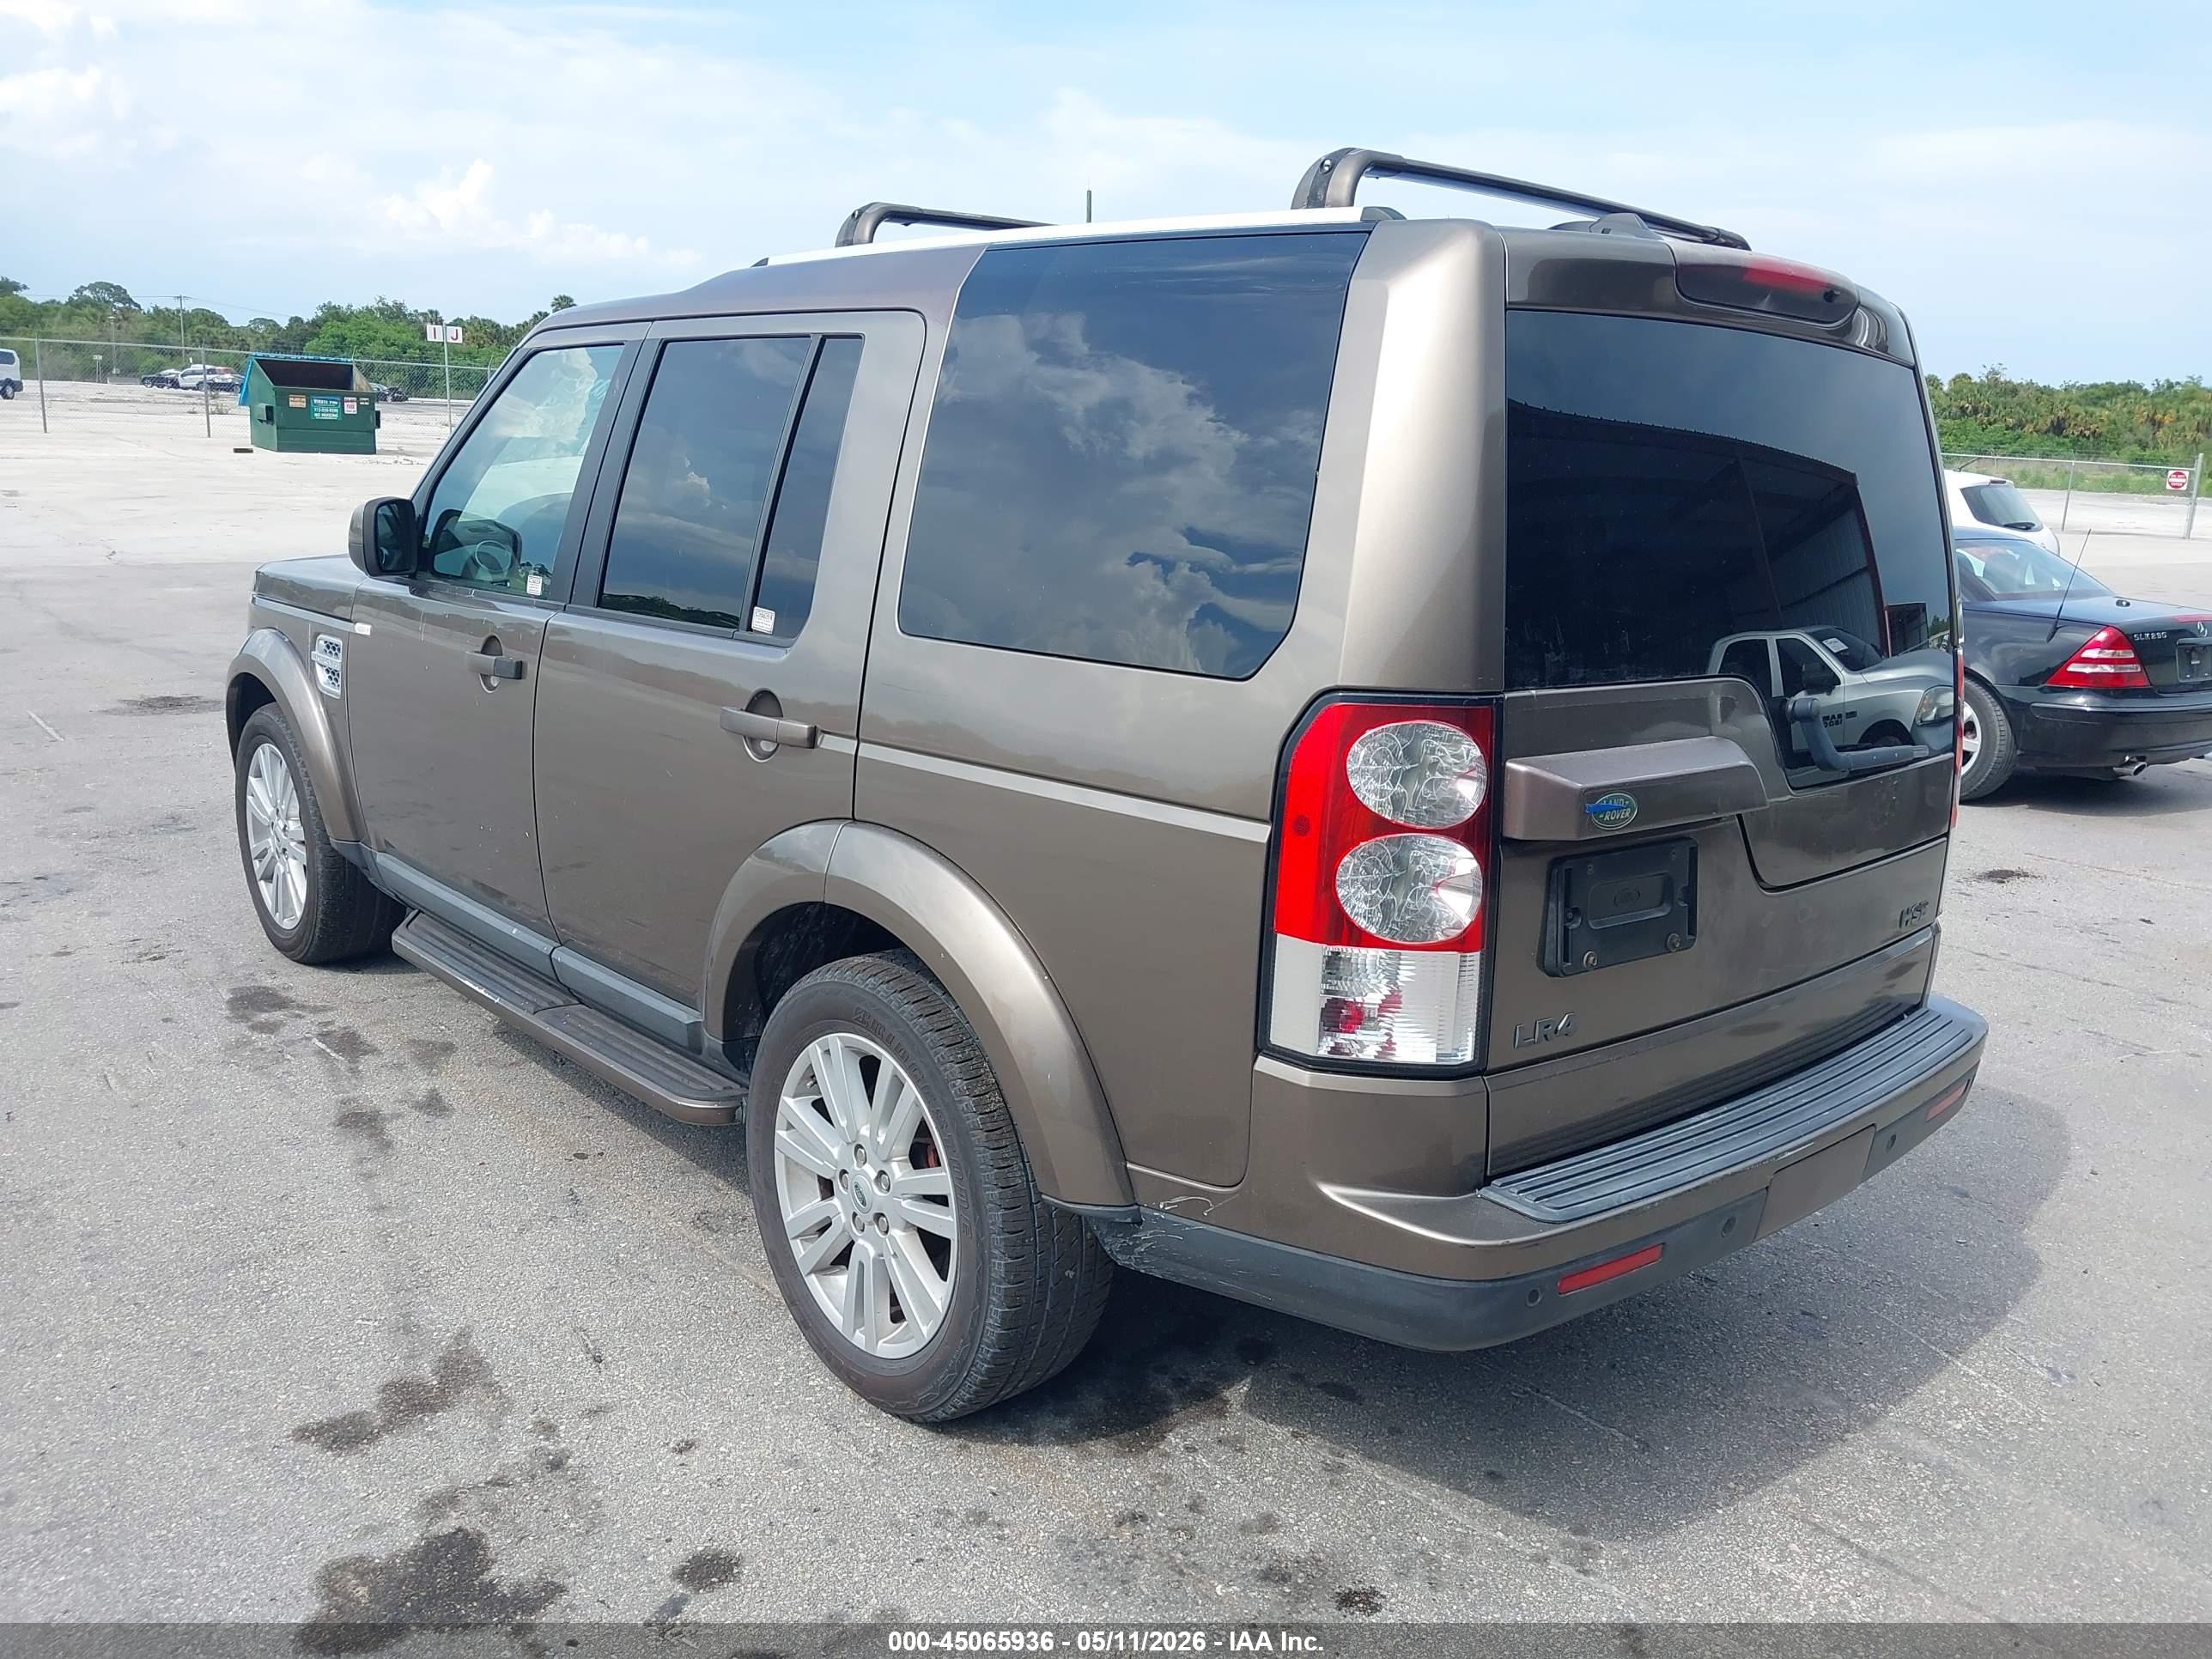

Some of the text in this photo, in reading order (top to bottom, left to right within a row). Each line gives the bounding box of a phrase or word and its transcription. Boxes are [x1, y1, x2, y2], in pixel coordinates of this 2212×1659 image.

[450, 328, 459, 341] J
[1603, 808, 1632, 821] ROVER
[1513, 1012, 1577, 1049] LR4
